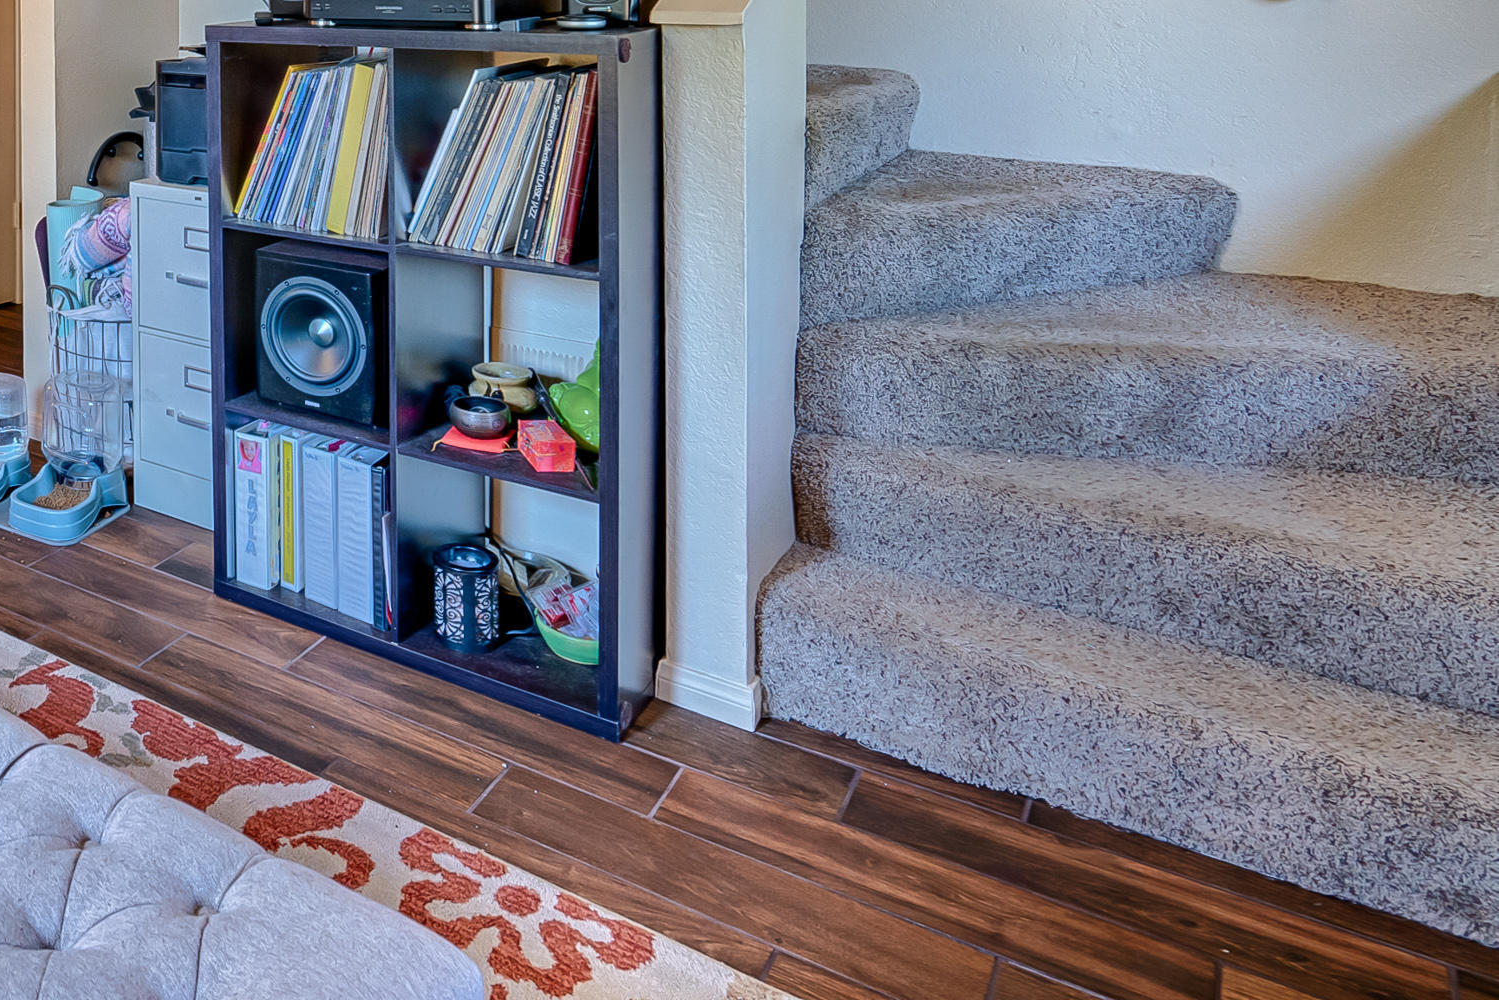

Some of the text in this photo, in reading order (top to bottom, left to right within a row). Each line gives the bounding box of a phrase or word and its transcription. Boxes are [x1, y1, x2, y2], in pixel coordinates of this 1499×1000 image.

[554, 94, 563, 104] the
[548, 104, 561, 138] Smithsonian
[539, 139, 553, 167] Collection
[528, 200, 540, 219] JAZZ
